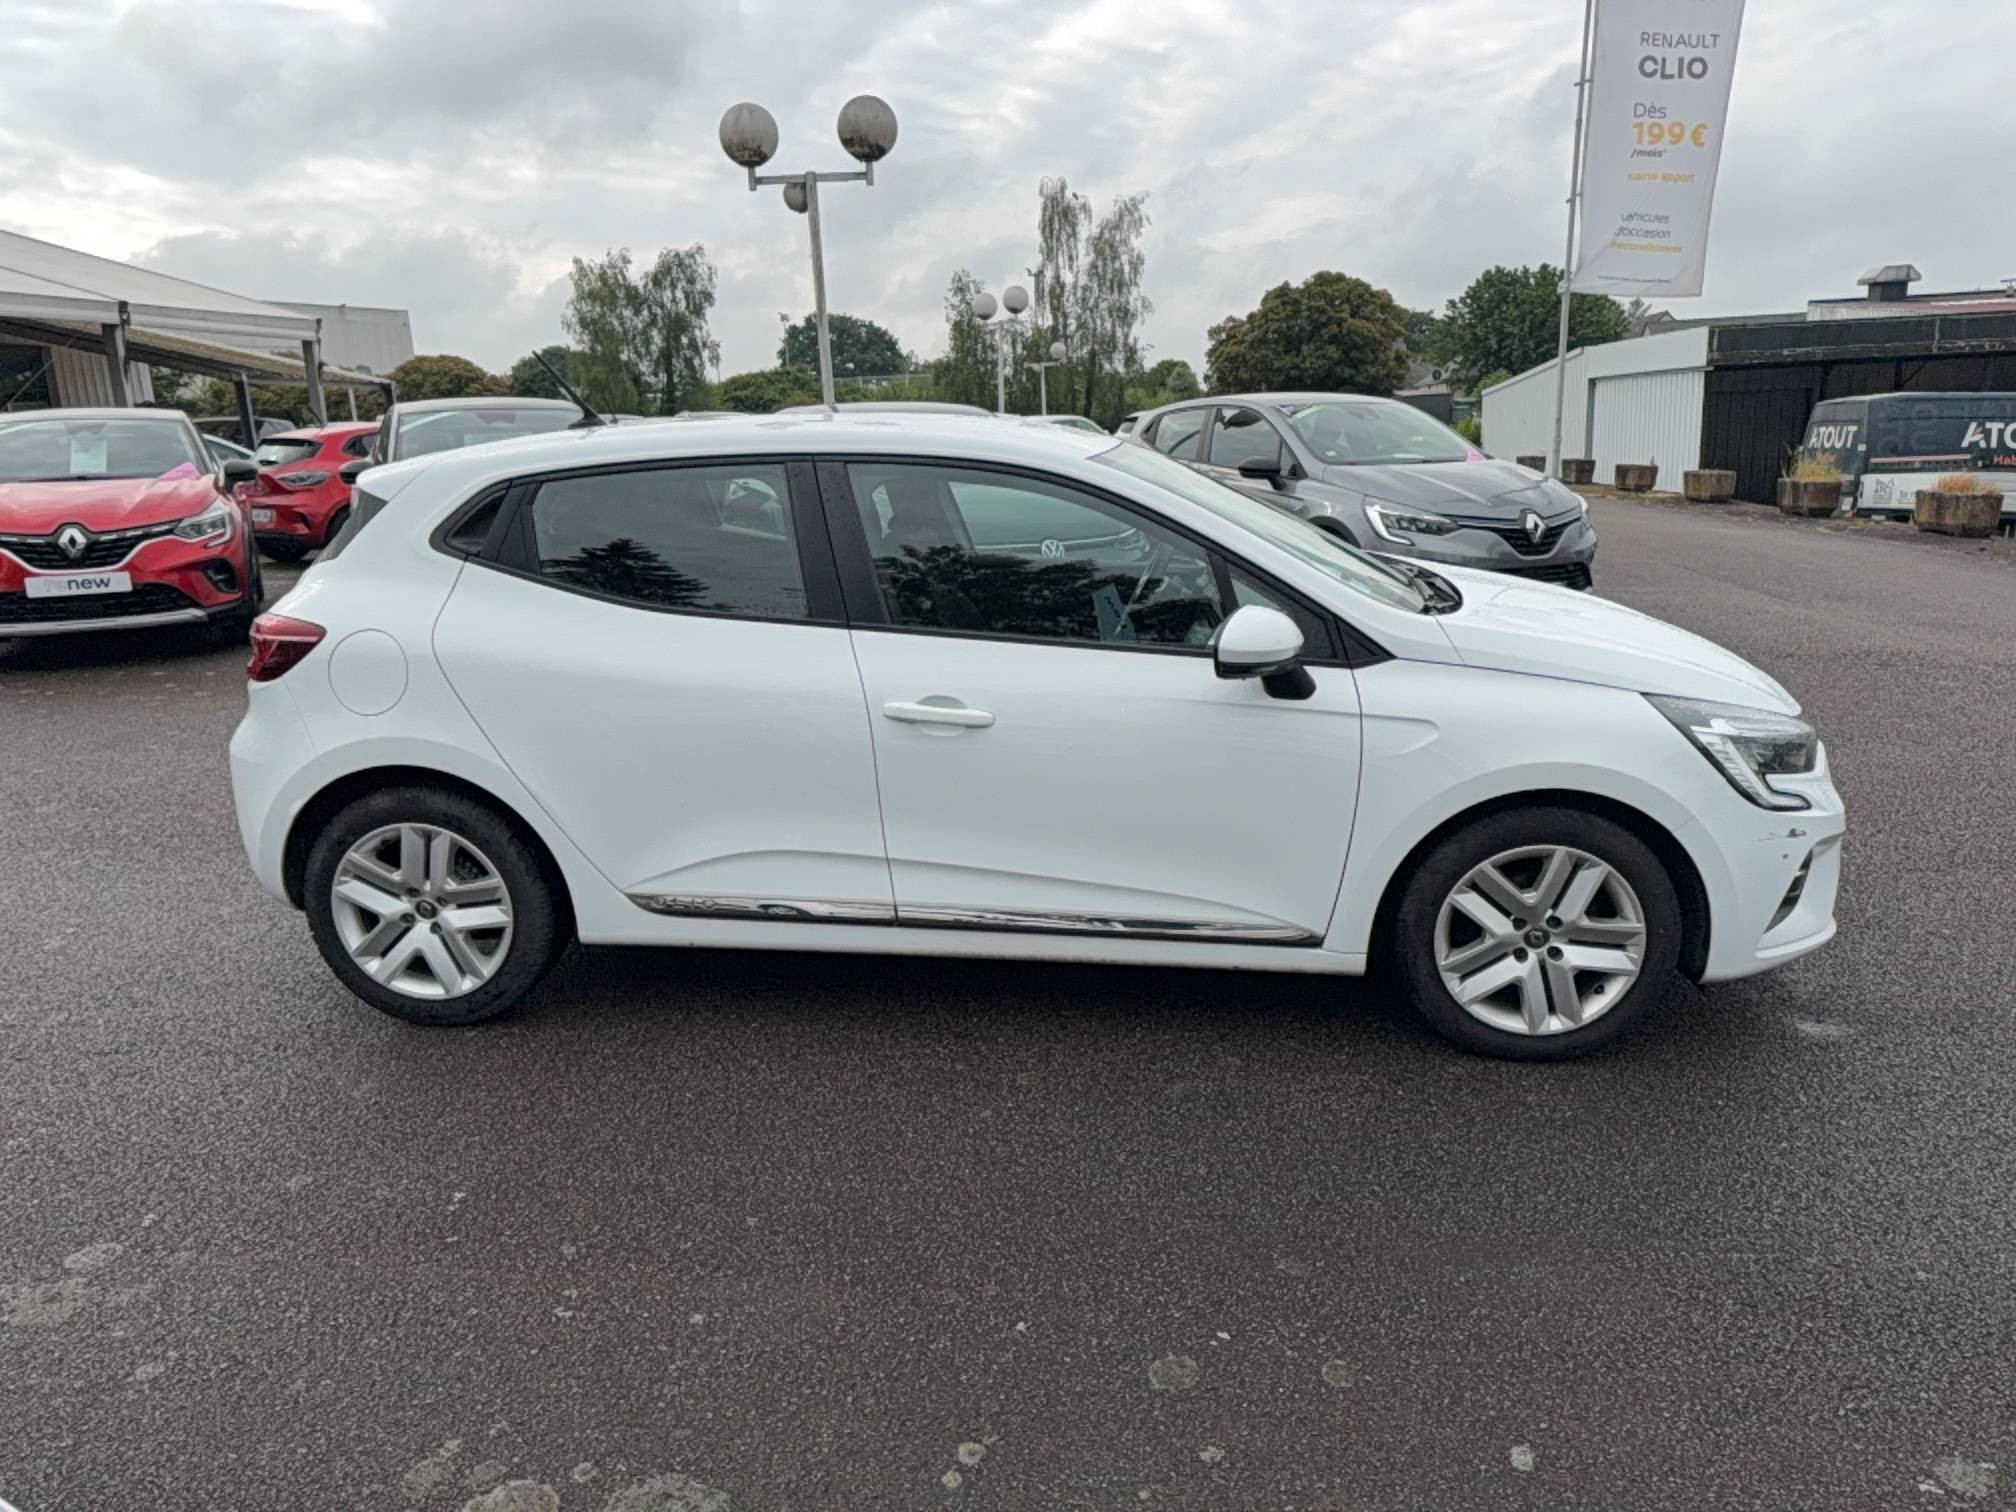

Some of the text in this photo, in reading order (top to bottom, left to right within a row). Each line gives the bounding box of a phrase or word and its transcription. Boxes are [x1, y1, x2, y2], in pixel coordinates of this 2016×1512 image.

[1640, 31, 1720, 48] RENAULT
[1638, 55, 1708, 79] CLIO
[1633, 101, 1667, 119] Dès
[1808, 425, 1858, 448] ATOUT
